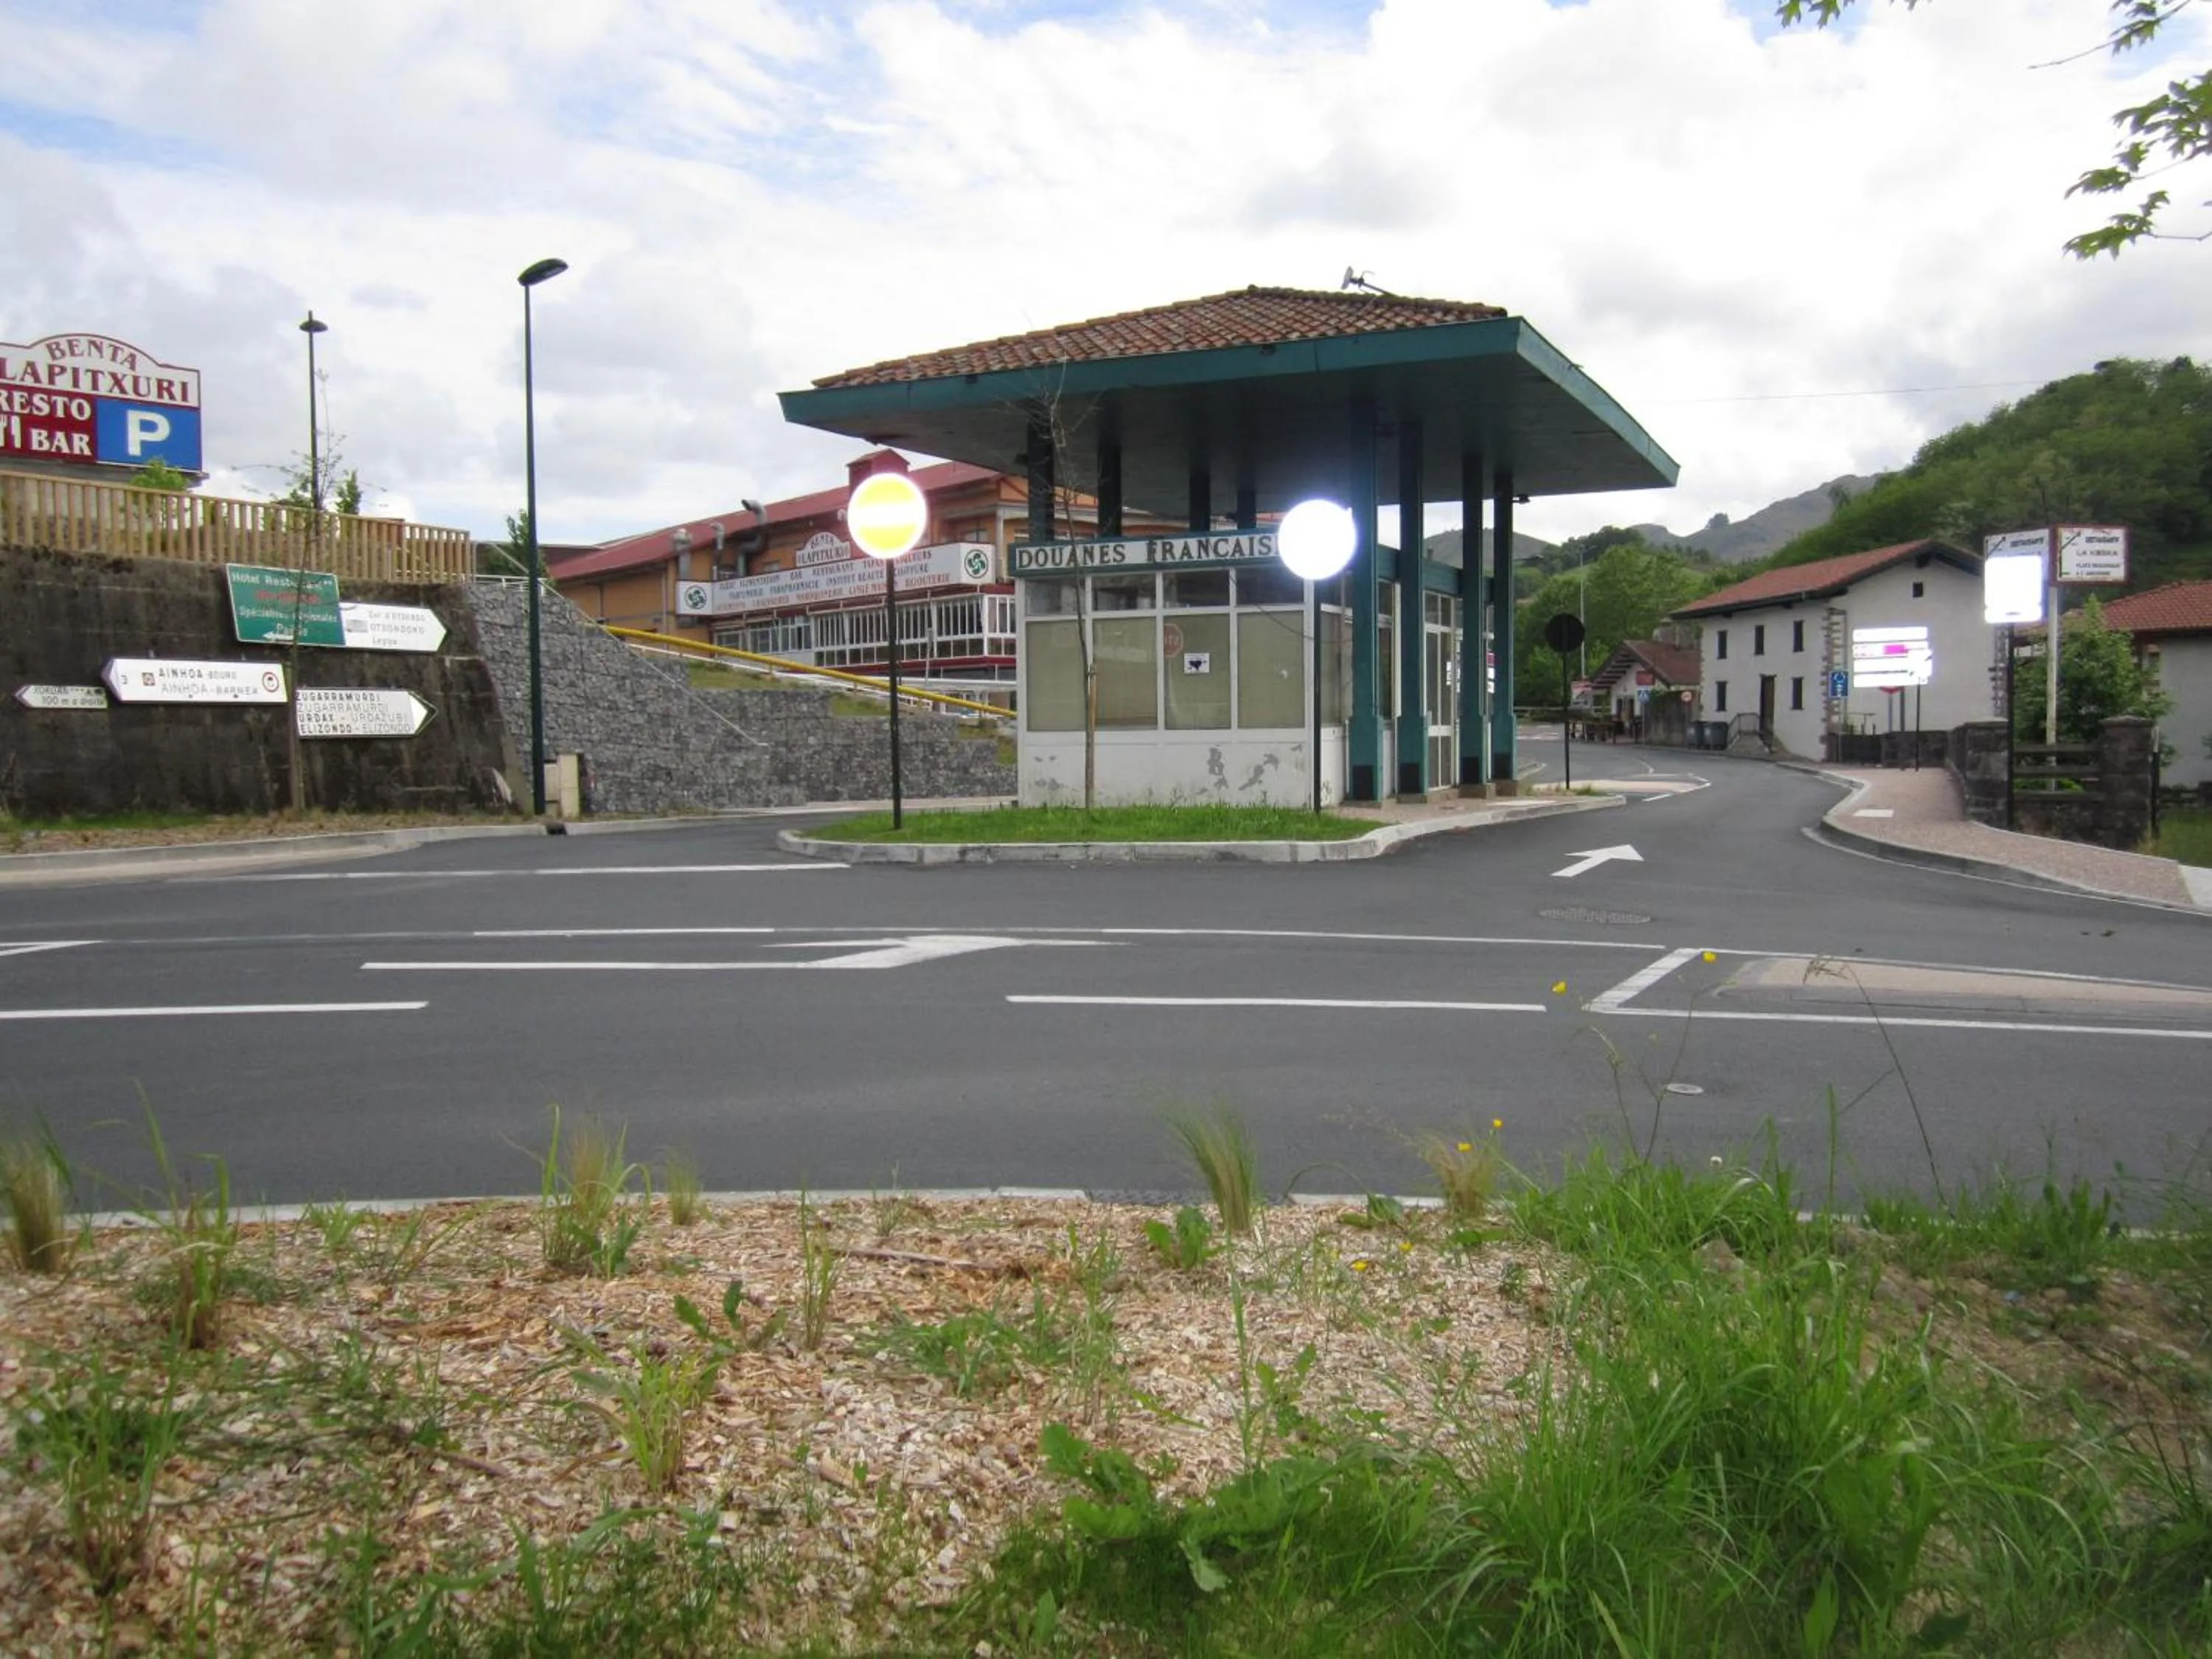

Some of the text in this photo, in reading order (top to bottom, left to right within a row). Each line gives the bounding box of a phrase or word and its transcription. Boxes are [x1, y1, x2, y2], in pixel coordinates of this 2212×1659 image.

[45, 338, 138, 371] BENTA
[0, 358, 189, 402] LAPITXURI
[30, 428, 92, 456] BAR
[127, 410, 170, 456] P
[1018, 536, 1279, 568] DOUANES FRANCAIS
[159, 667, 204, 679] AINHOA
[296, 692, 380, 702] ZUGARRAMURDI
[297, 703, 389, 713] ZUGARRAMURDI
[299, 713, 334, 723] URDAX
[301, 724, 352, 734] ELIZONDO
